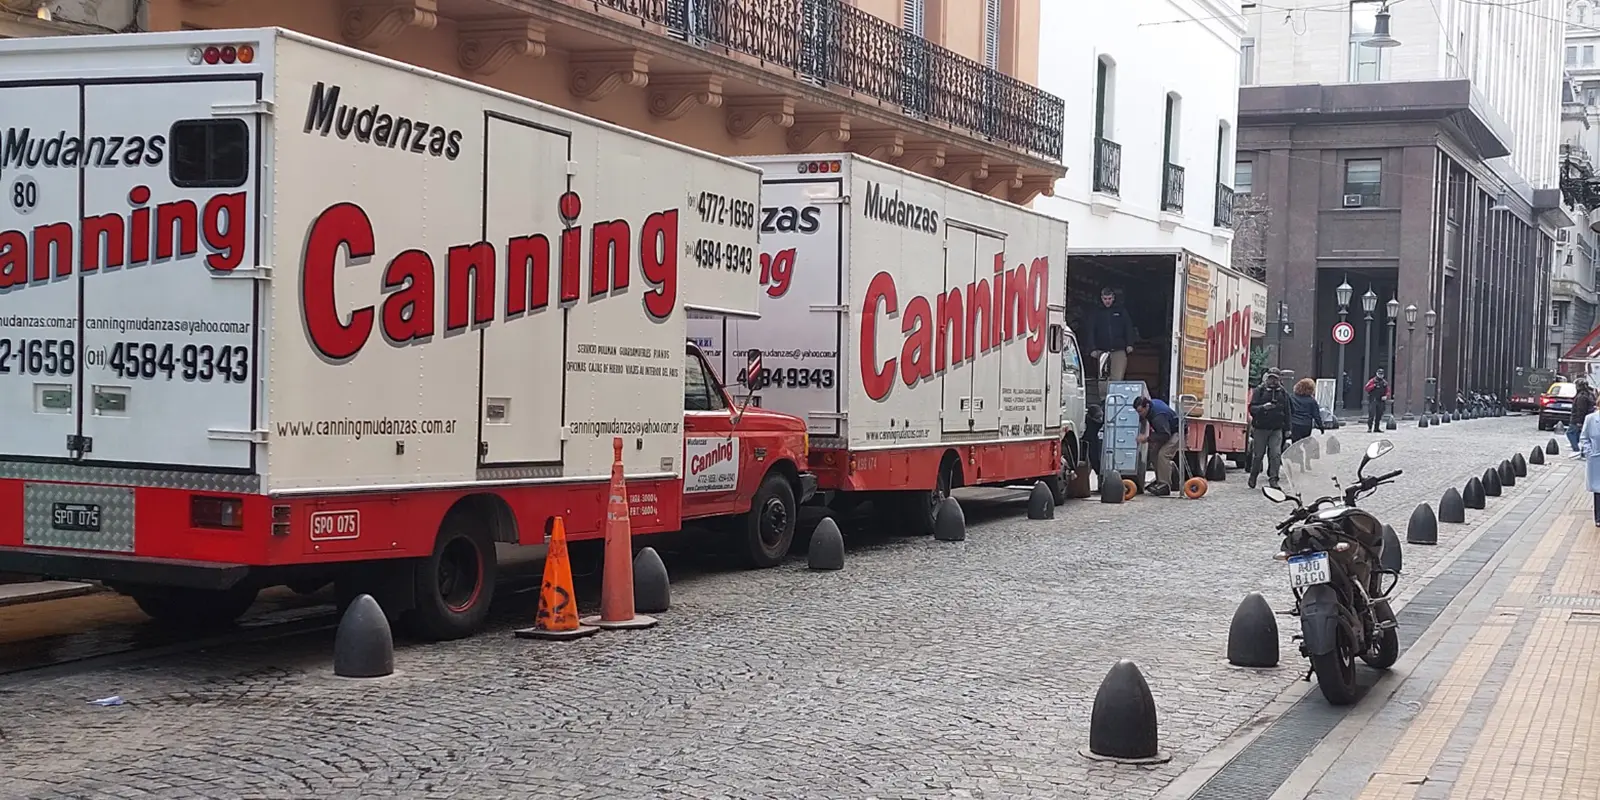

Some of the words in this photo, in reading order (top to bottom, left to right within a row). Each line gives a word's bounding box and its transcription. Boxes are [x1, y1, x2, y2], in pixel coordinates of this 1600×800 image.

[304, 82, 462, 161] Mudanzas
[3, 128, 165, 169] Mudanzas
[14, 182, 36, 207] 80
[698, 191, 754, 229] 4772-1658
[864, 180, 938, 235] Mudanzas
[695, 238, 752, 275] 4584-9343
[299, 191, 679, 366] Canning
[860, 252, 1048, 403] Canning
[1338, 328, 1350, 338] 10
[108, 342, 249, 383] 4584-9343
[736, 368, 836, 389] 484-9343
[277, 417, 457, 440] www.canningmudanzas.com.ar
[691, 441, 733, 475] Canning
[54, 510, 73, 525] SPO
[78, 511, 98, 526] 075
[314, 516, 333, 534] SPO
[337, 515, 355, 533] 075
